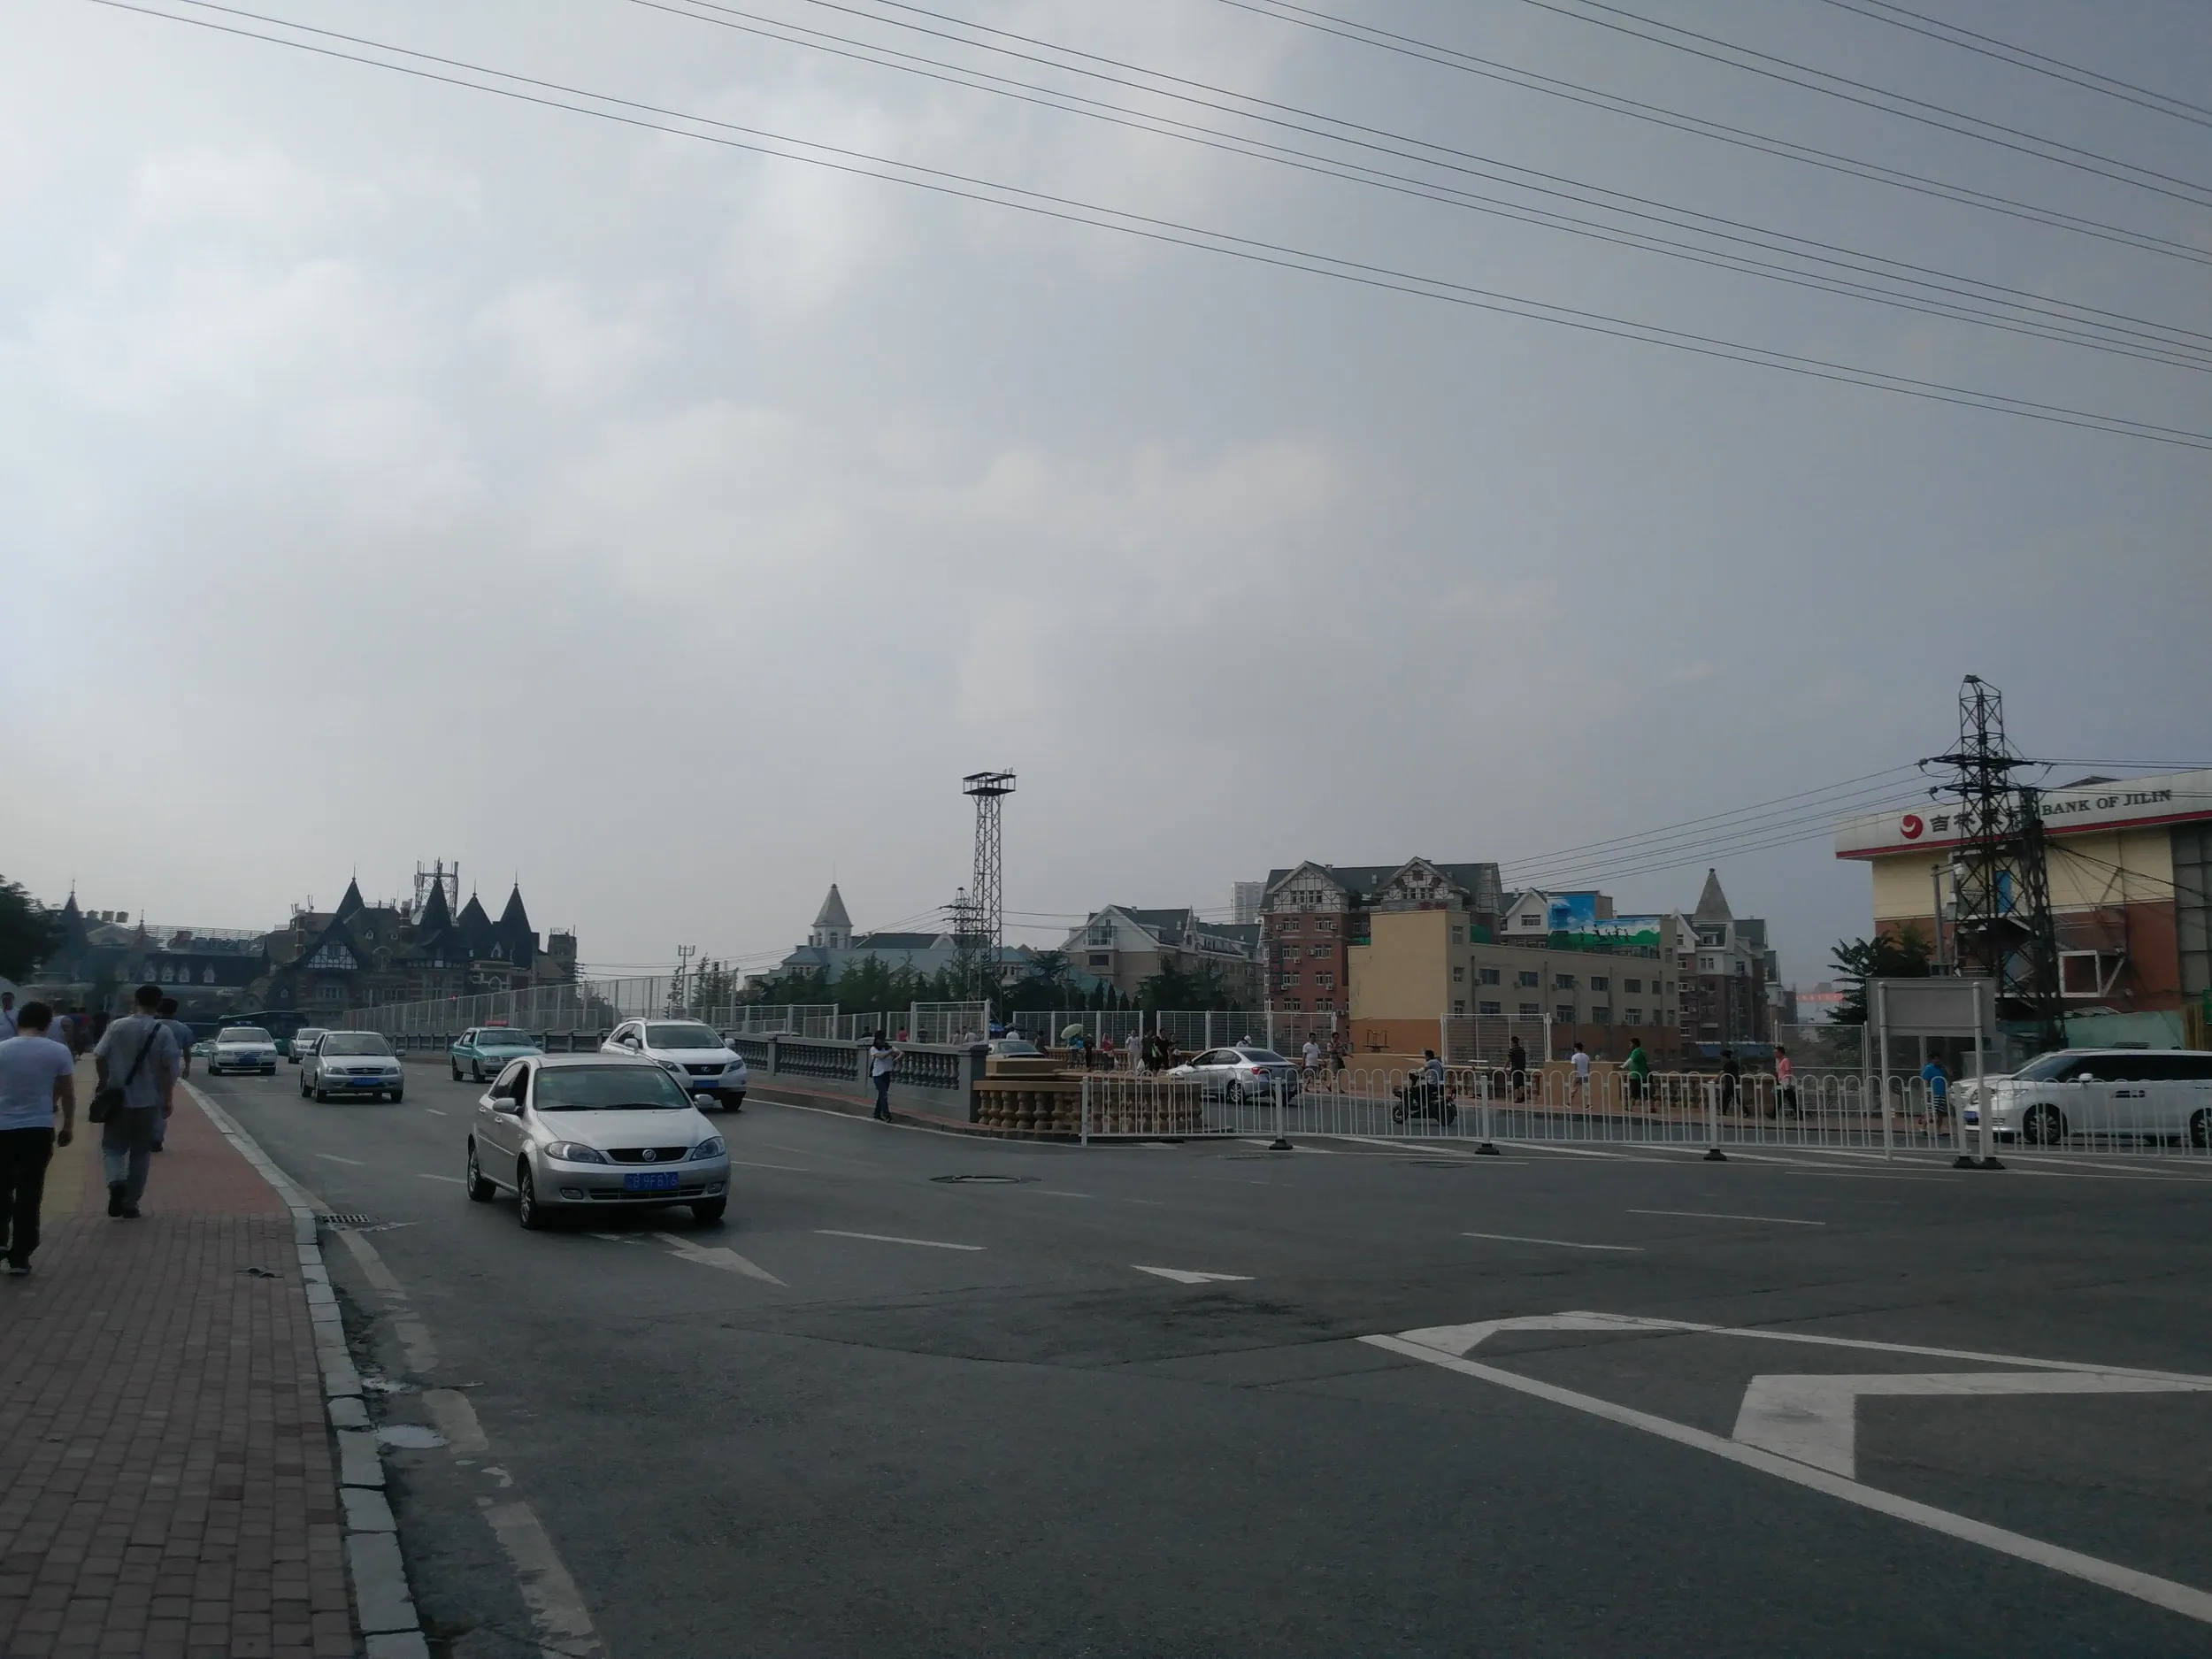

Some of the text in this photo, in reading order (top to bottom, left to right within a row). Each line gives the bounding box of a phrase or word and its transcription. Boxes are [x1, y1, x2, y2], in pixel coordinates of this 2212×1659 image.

[2042, 789, 2171, 816] BANK OF JILIN
